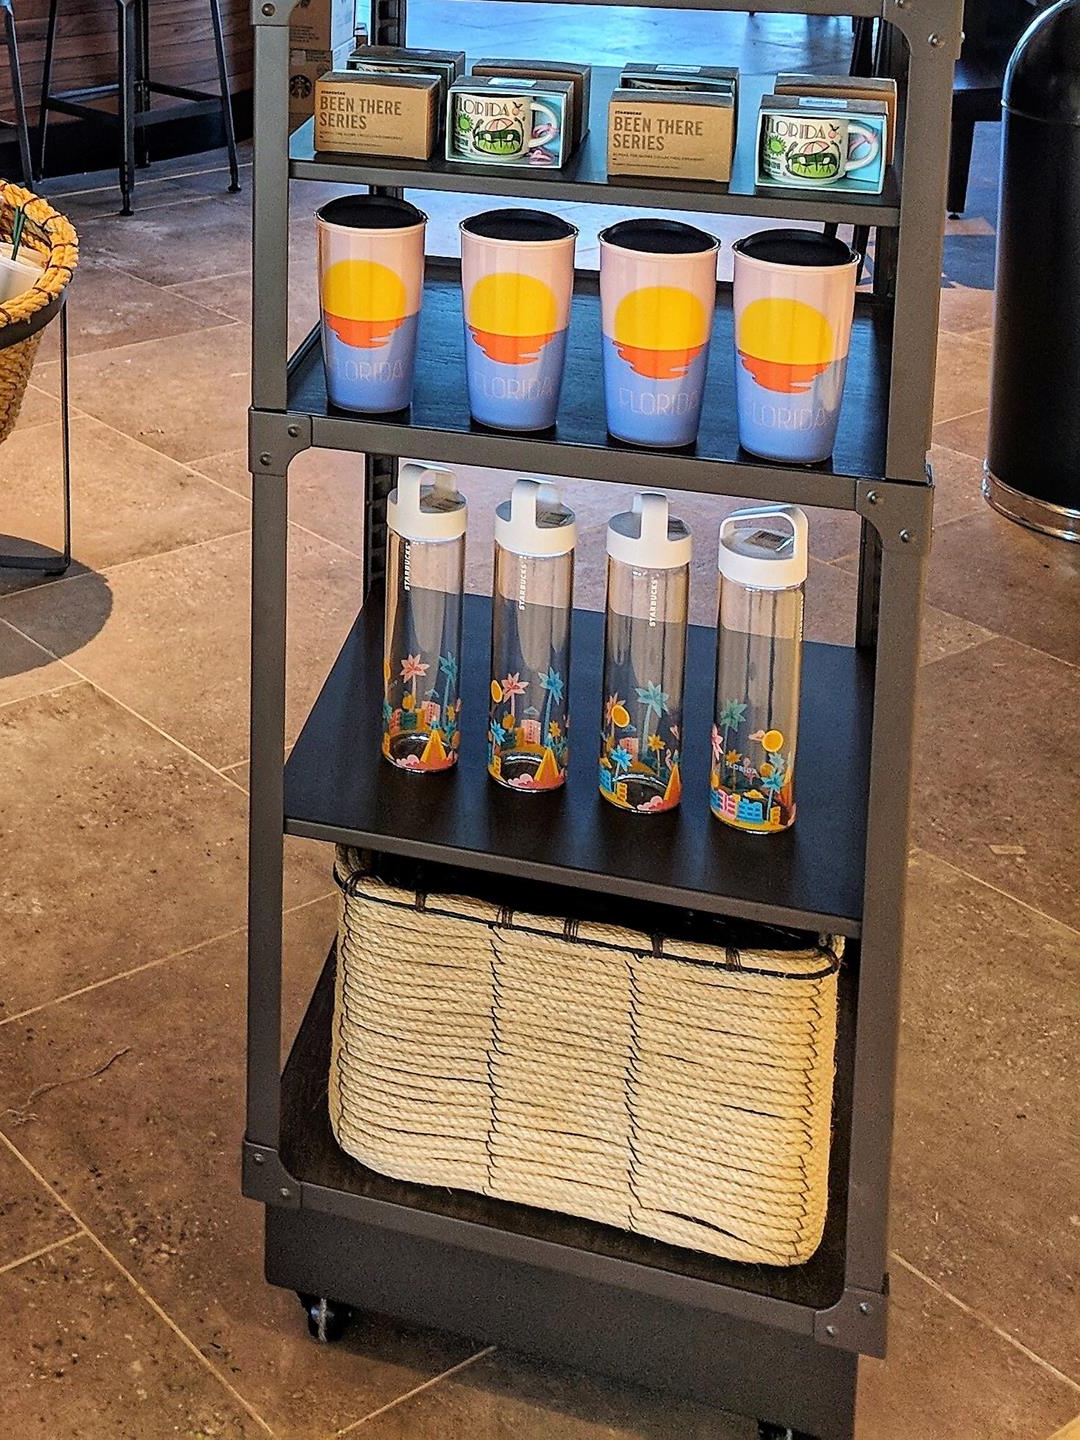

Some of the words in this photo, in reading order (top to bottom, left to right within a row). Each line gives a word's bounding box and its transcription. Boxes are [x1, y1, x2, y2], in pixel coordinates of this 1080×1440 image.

[320, 96, 354, 113] BEEN
[360, 98, 402, 116] THERE
[319, 112, 367, 130] SERIES
[614, 116, 651, 133] BEEN
[657, 118, 703, 136] THERE
[613, 133, 665, 151] SERIES
[619, 388, 697, 417] FLORIDA
[519, 563, 527, 611] STARBUCKS
[649, 578, 658, 627] STARBUCKS
